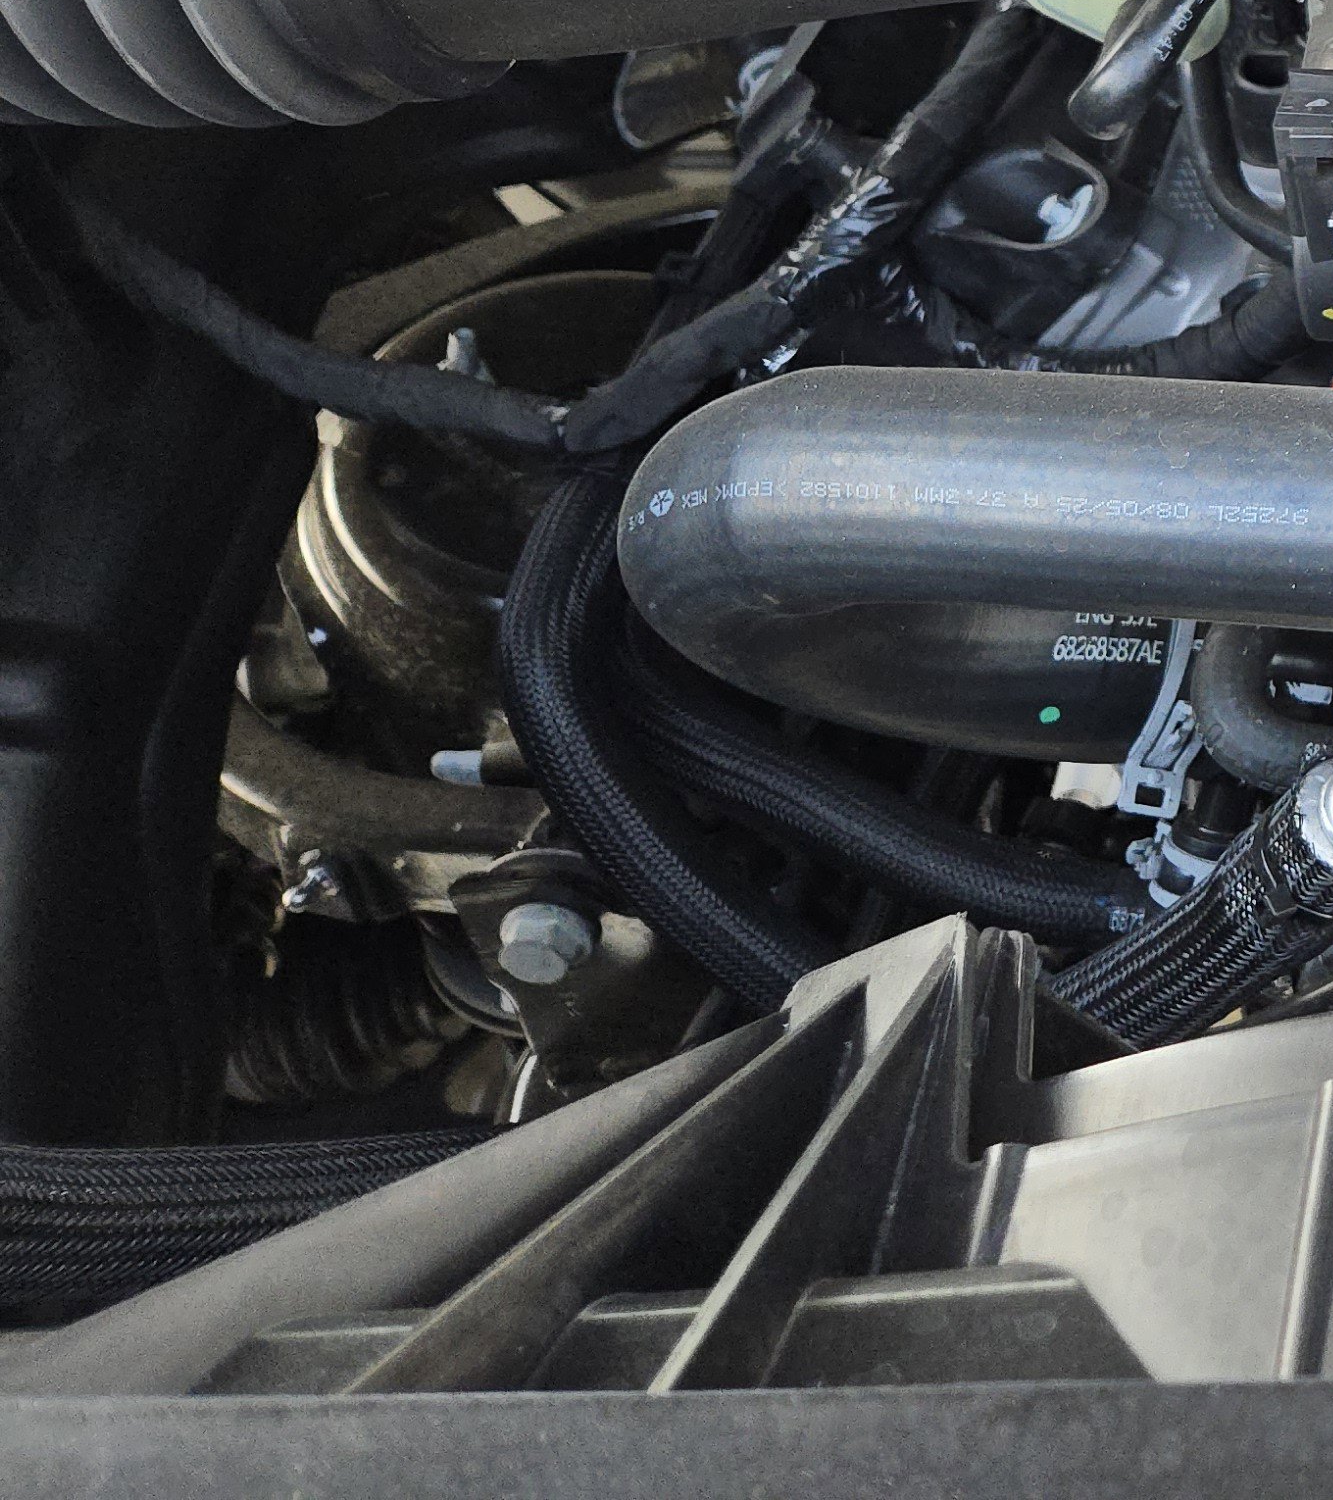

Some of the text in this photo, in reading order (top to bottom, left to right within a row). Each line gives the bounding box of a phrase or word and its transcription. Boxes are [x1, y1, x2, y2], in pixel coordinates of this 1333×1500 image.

[679, 486, 711, 510] MEX
[800, 479, 898, 501] 1101582
[1023, 491, 1040, 509] A
[1056, 495, 1190, 521] 08/05/25
[1208, 502, 1310, 527] 97252L
[1052, 635, 1165, 665] 68268587AE
